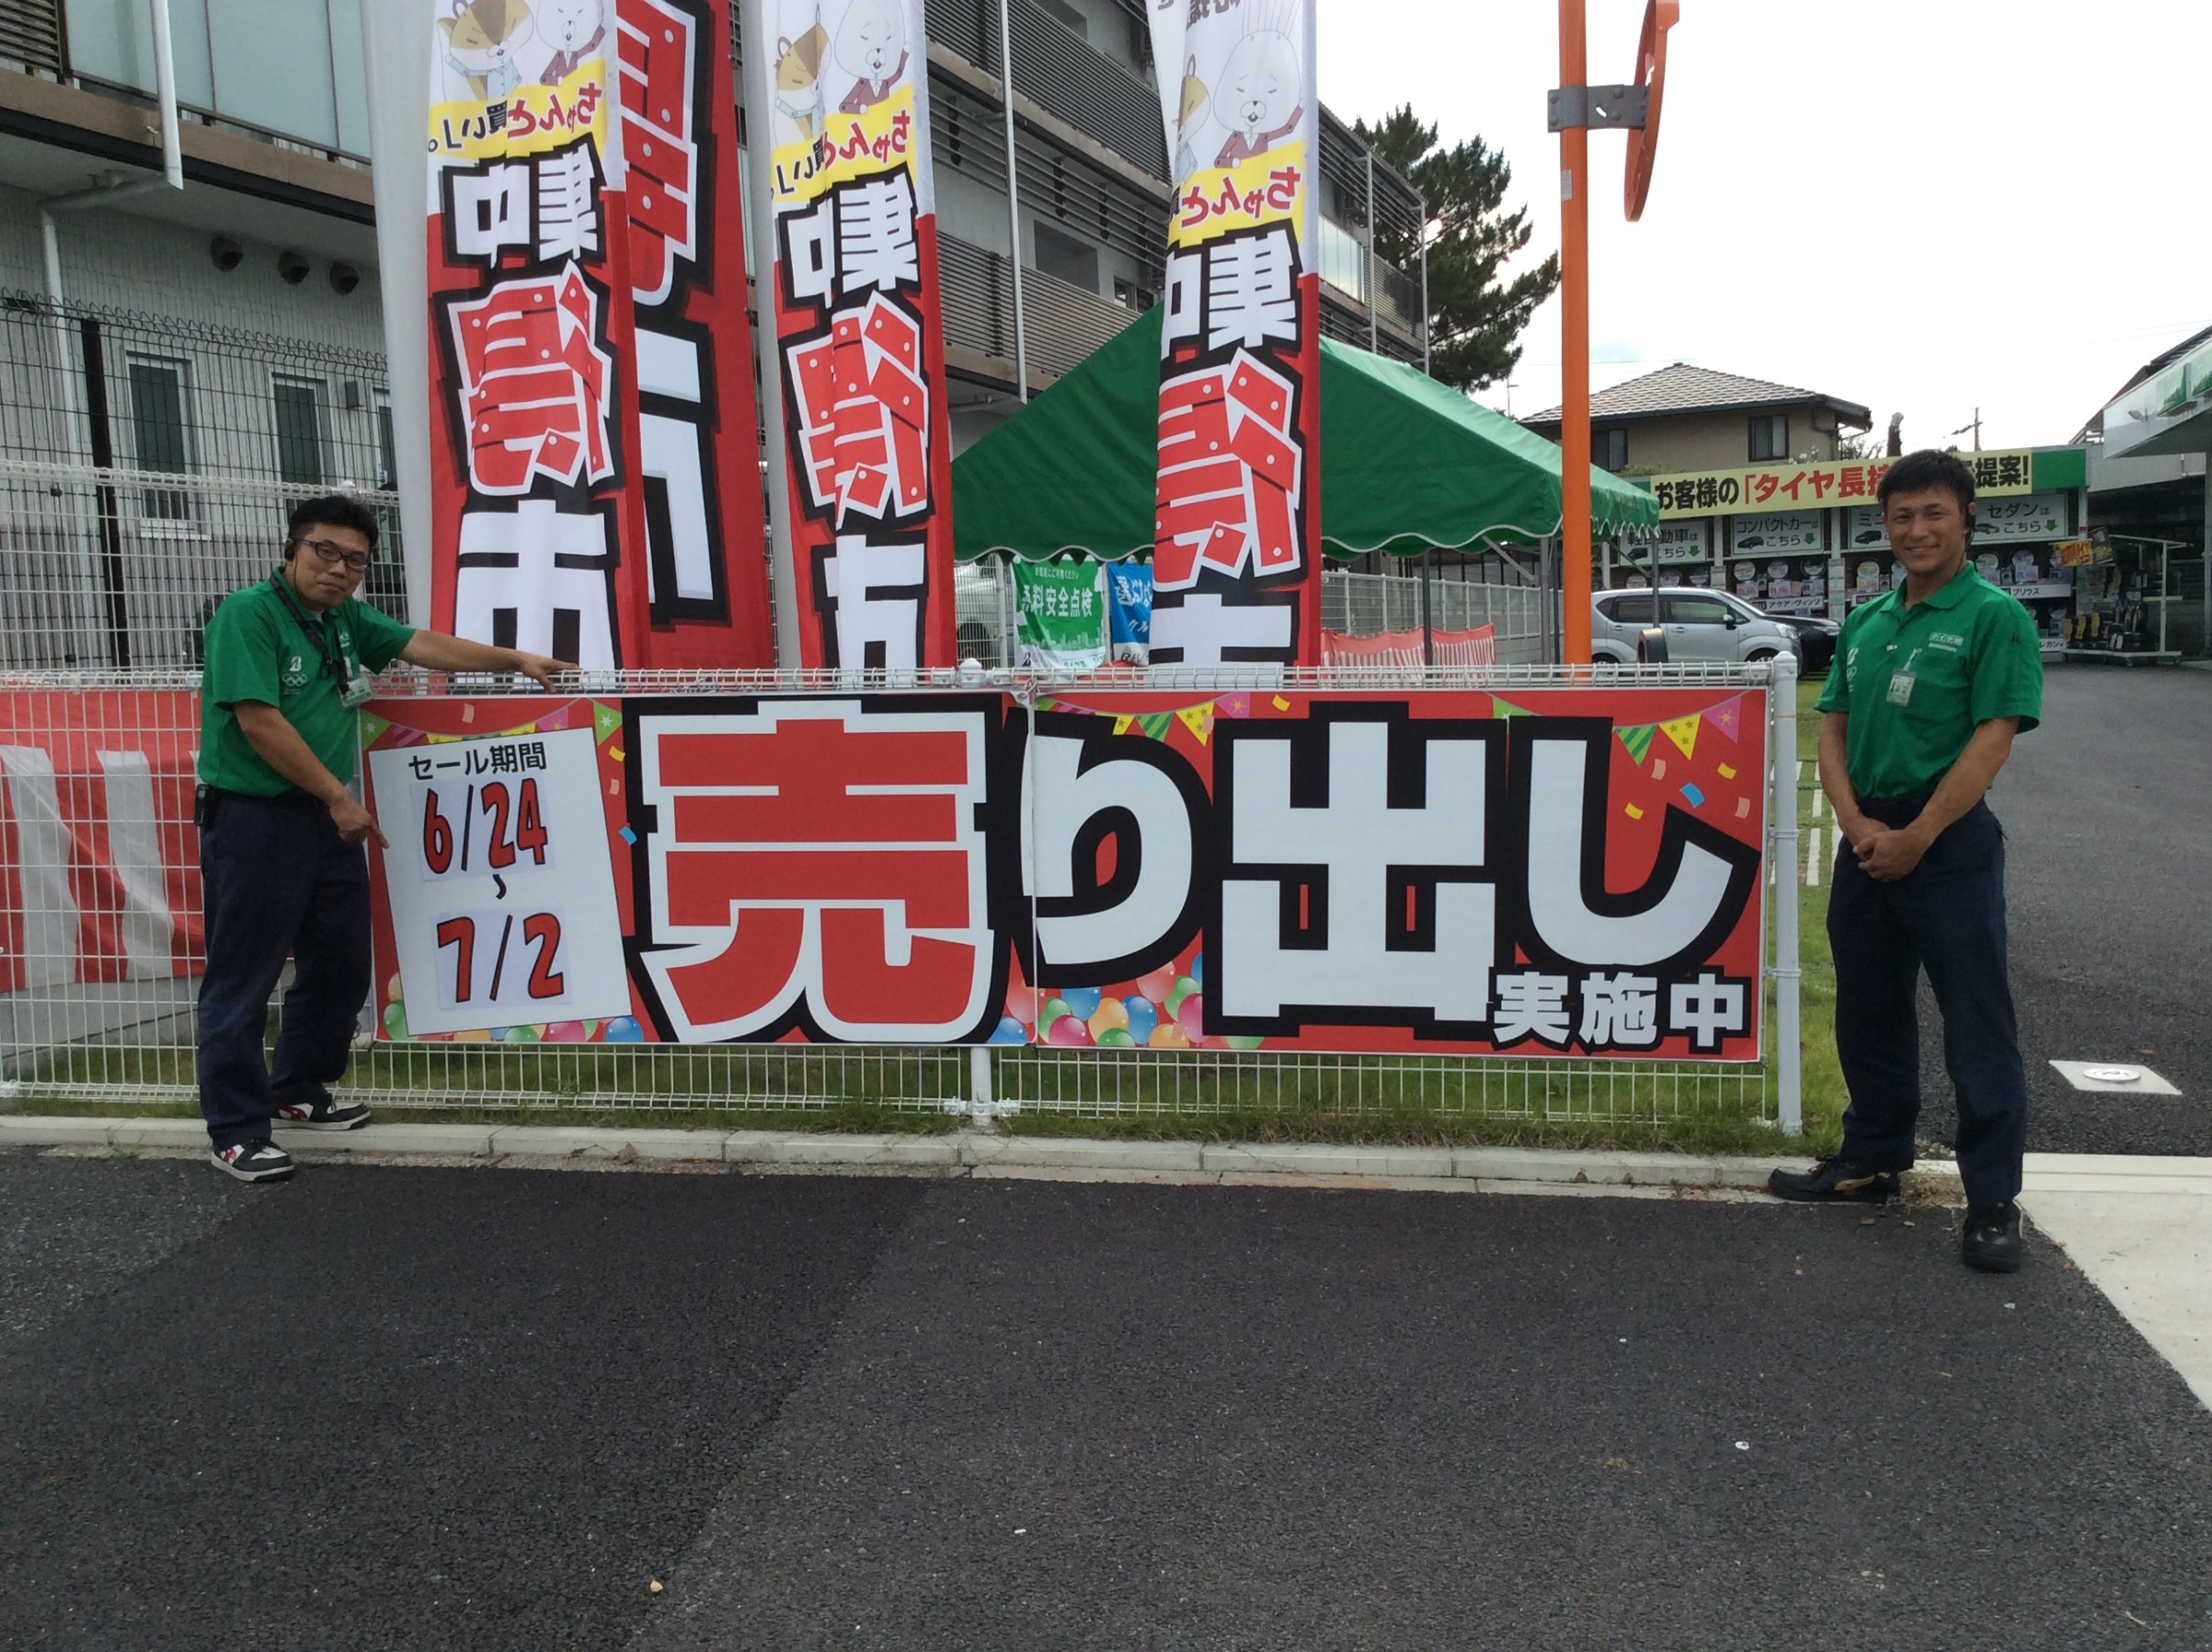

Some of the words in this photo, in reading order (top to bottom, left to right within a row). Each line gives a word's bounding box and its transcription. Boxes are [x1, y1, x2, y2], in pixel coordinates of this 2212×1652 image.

[1966, 454, 2029, 489] 提案!
[1736, 516, 1818, 533] コンパクトカーは
[1987, 502, 2051, 519] セダンは
[2003, 521, 2041, 533] こちら
[1766, 534, 1801, 547] こちら
[408, 741, 547, 781] セール期間
[422, 777, 548, 876] 6/24
[638, 700, 1735, 1043] 売り出し
[436, 912, 565, 1004] 7/2
[1493, 971, 1747, 1047] 実施中
